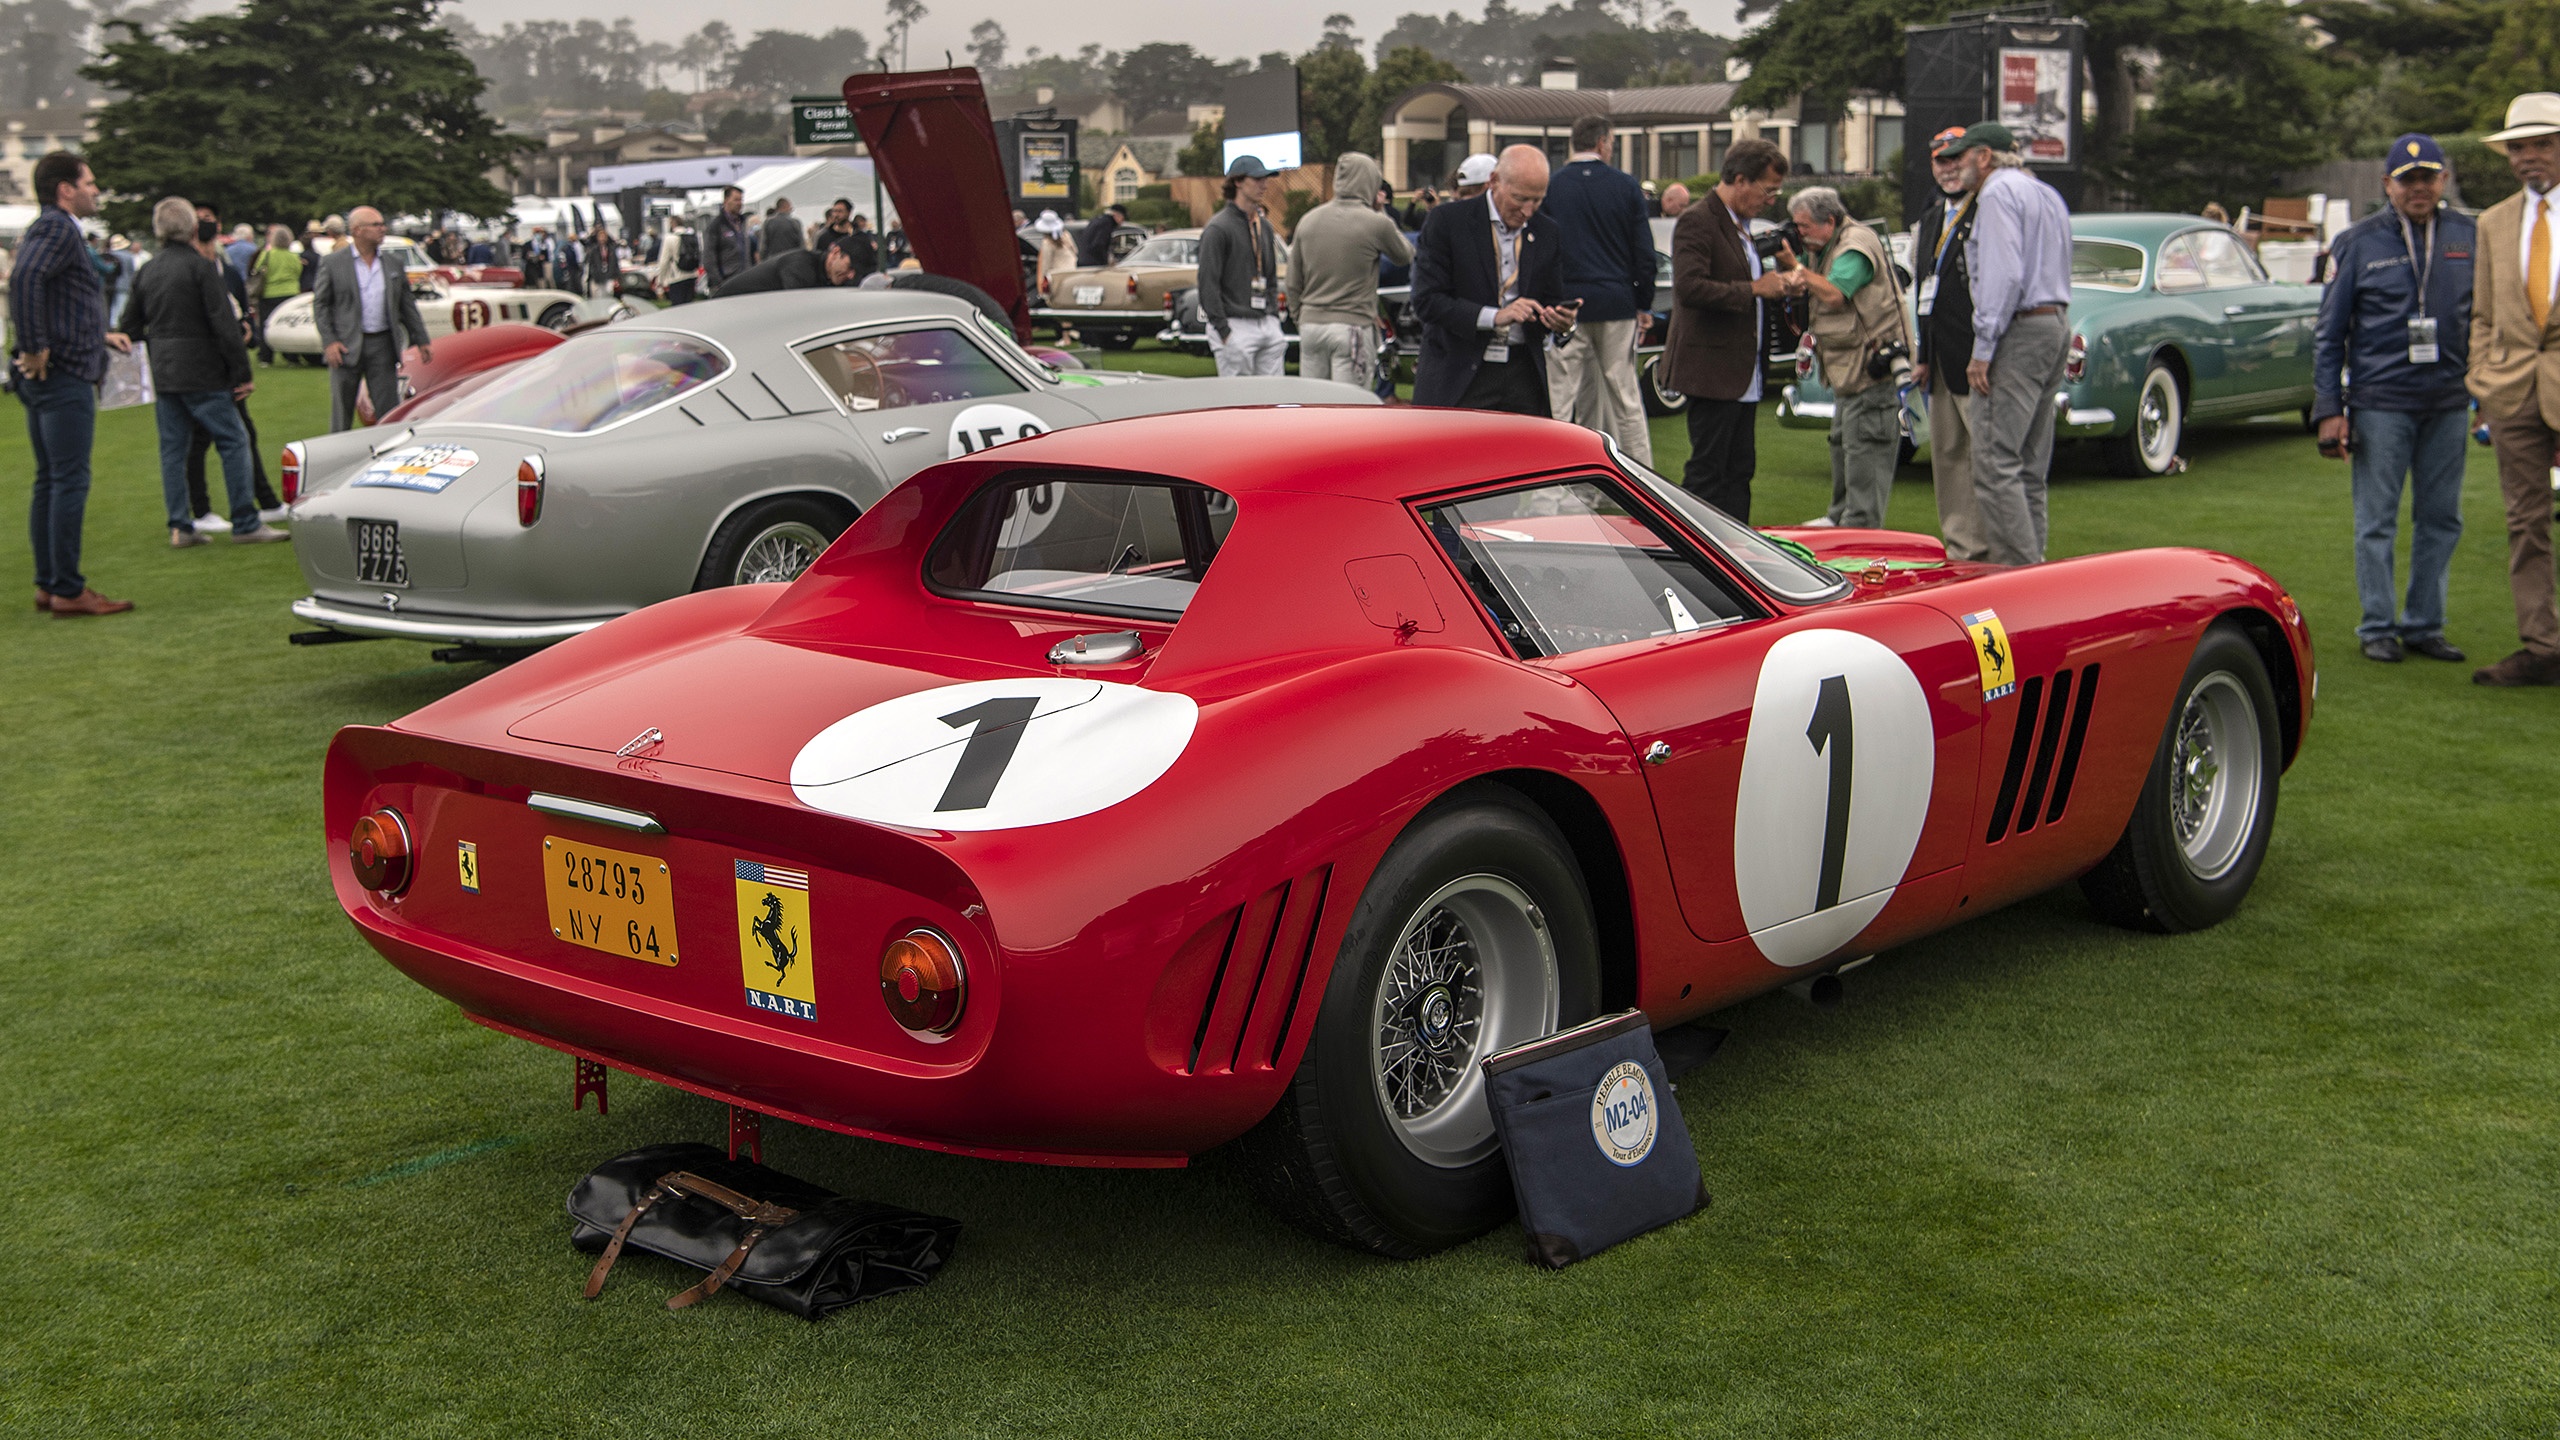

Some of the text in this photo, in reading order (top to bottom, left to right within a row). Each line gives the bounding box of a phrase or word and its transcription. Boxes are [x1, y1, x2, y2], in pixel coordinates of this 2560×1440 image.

[803, 107, 834, 119] Class
[815, 120, 848, 131] Ferrari
[461, 302, 484, 332] 13
[360, 523, 403, 553] 866
[933, 696, 1042, 813] 1
[1805, 673, 1853, 913] 1
[565, 851, 645, 905] 28793
[568, 908, 660, 958] NY 64
[749, 989, 814, 1020] N.A.R.T.
[1596, 1063, 1646, 1106] PEBBLE BEACH
[1604, 1090, 1648, 1134] M2-04
[1612, 1146, 1627, 1161] Tour
